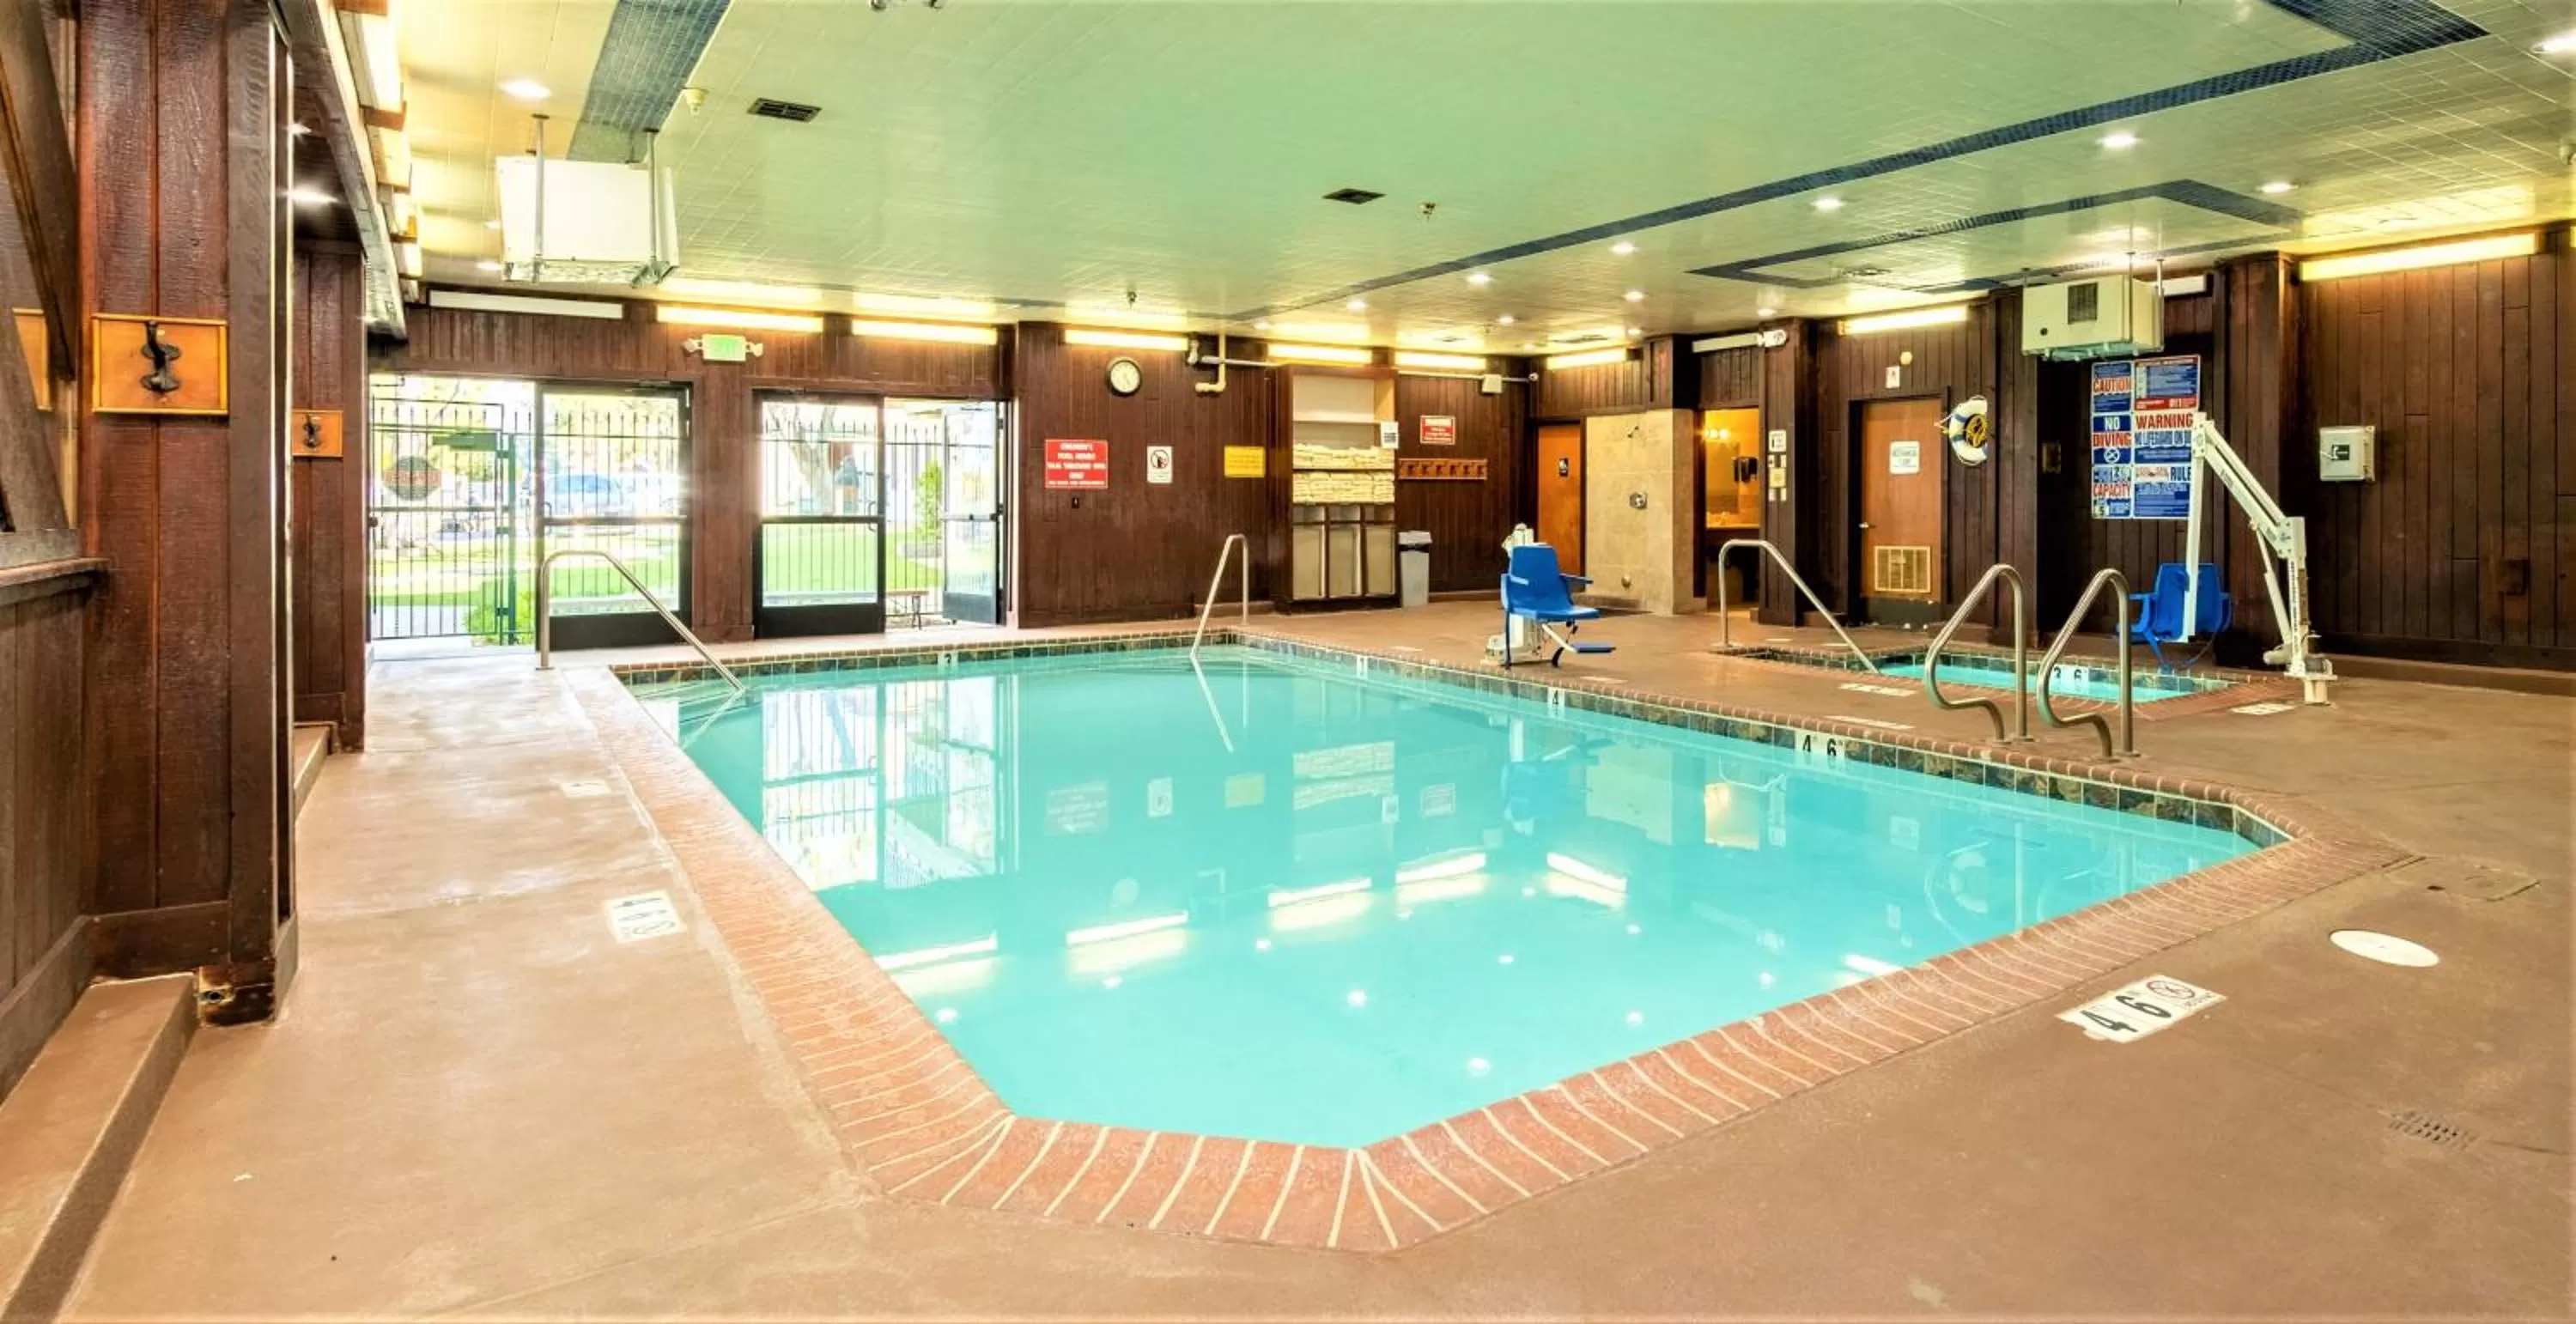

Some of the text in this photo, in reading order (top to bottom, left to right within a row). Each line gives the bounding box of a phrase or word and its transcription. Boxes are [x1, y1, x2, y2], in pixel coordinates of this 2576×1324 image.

[2105, 416, 2120, 430] NO
[2136, 413, 2193, 429] WARNING
[2093, 433, 2131, 447] DIVING
[2171, 466, 2191, 481] RULE
[2079, 1009, 2139, 1034] 4
[2115, 994, 2172, 1018] 6
